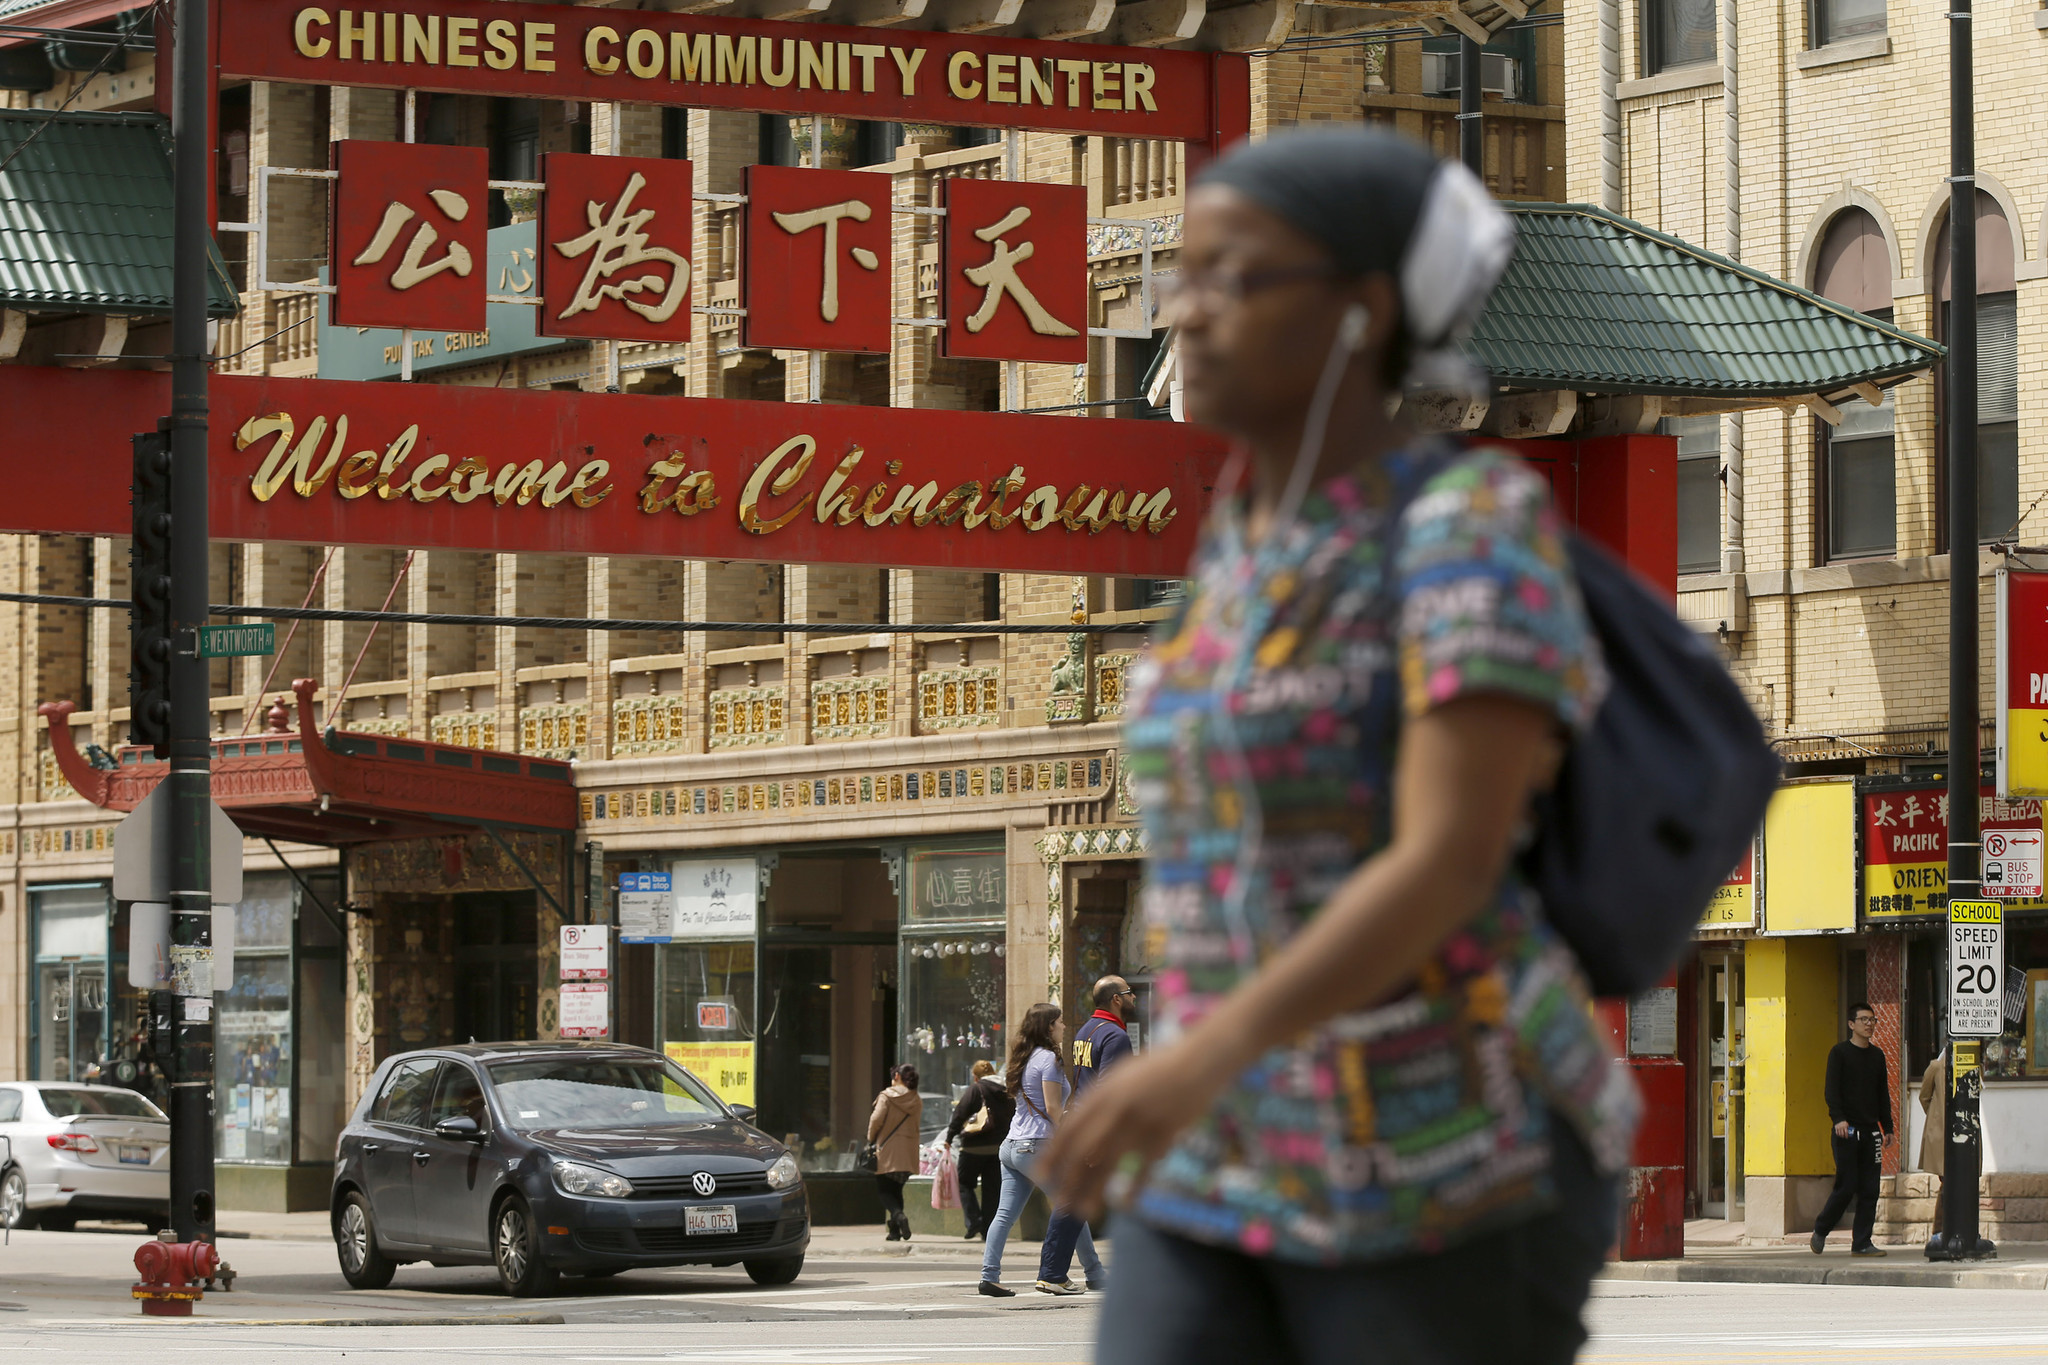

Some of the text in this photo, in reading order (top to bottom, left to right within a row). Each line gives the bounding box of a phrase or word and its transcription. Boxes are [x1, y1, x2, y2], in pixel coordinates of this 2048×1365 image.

[295, 7, 1158, 112] CHINESE COMMUNITY CENTER
[353, 189, 472, 291] 公
[773, 200, 879, 322] 下
[964, 206, 1080, 337] 天
[384, 328, 490, 365] PUI TAK CENTER
[235, 411, 1178, 535] Welcome to Chinatown
[205, 628, 273, 653] S WENTWORTH AV
[1893, 833, 1940, 852] PACIFIC
[2007, 862, 2029, 872] BUS
[1894, 867, 1948, 889] ORIEN
[2007, 873, 2034, 884] STOP
[1985, 886, 2037, 895] TOW ZONE
[1953, 905, 2000, 920] SCHOOL
[1954, 928, 1998, 943] SPEED
[576, 953, 590, 961] Stop
[1959, 946, 1993, 960] LIMIT
[1956, 964, 1997, 994] 20
[1953, 999, 1999, 1008] ON SCHOOL DAYS
[700, 1006, 728, 1027] OPEN
[1955, 1009, 1998, 1018] WHEN CHILDREN
[1958, 1019, 1994, 1028] ARE PRESENT
[737, 1071, 747, 1086] OFF
[688, 1213, 734, 1229] H46 0753
